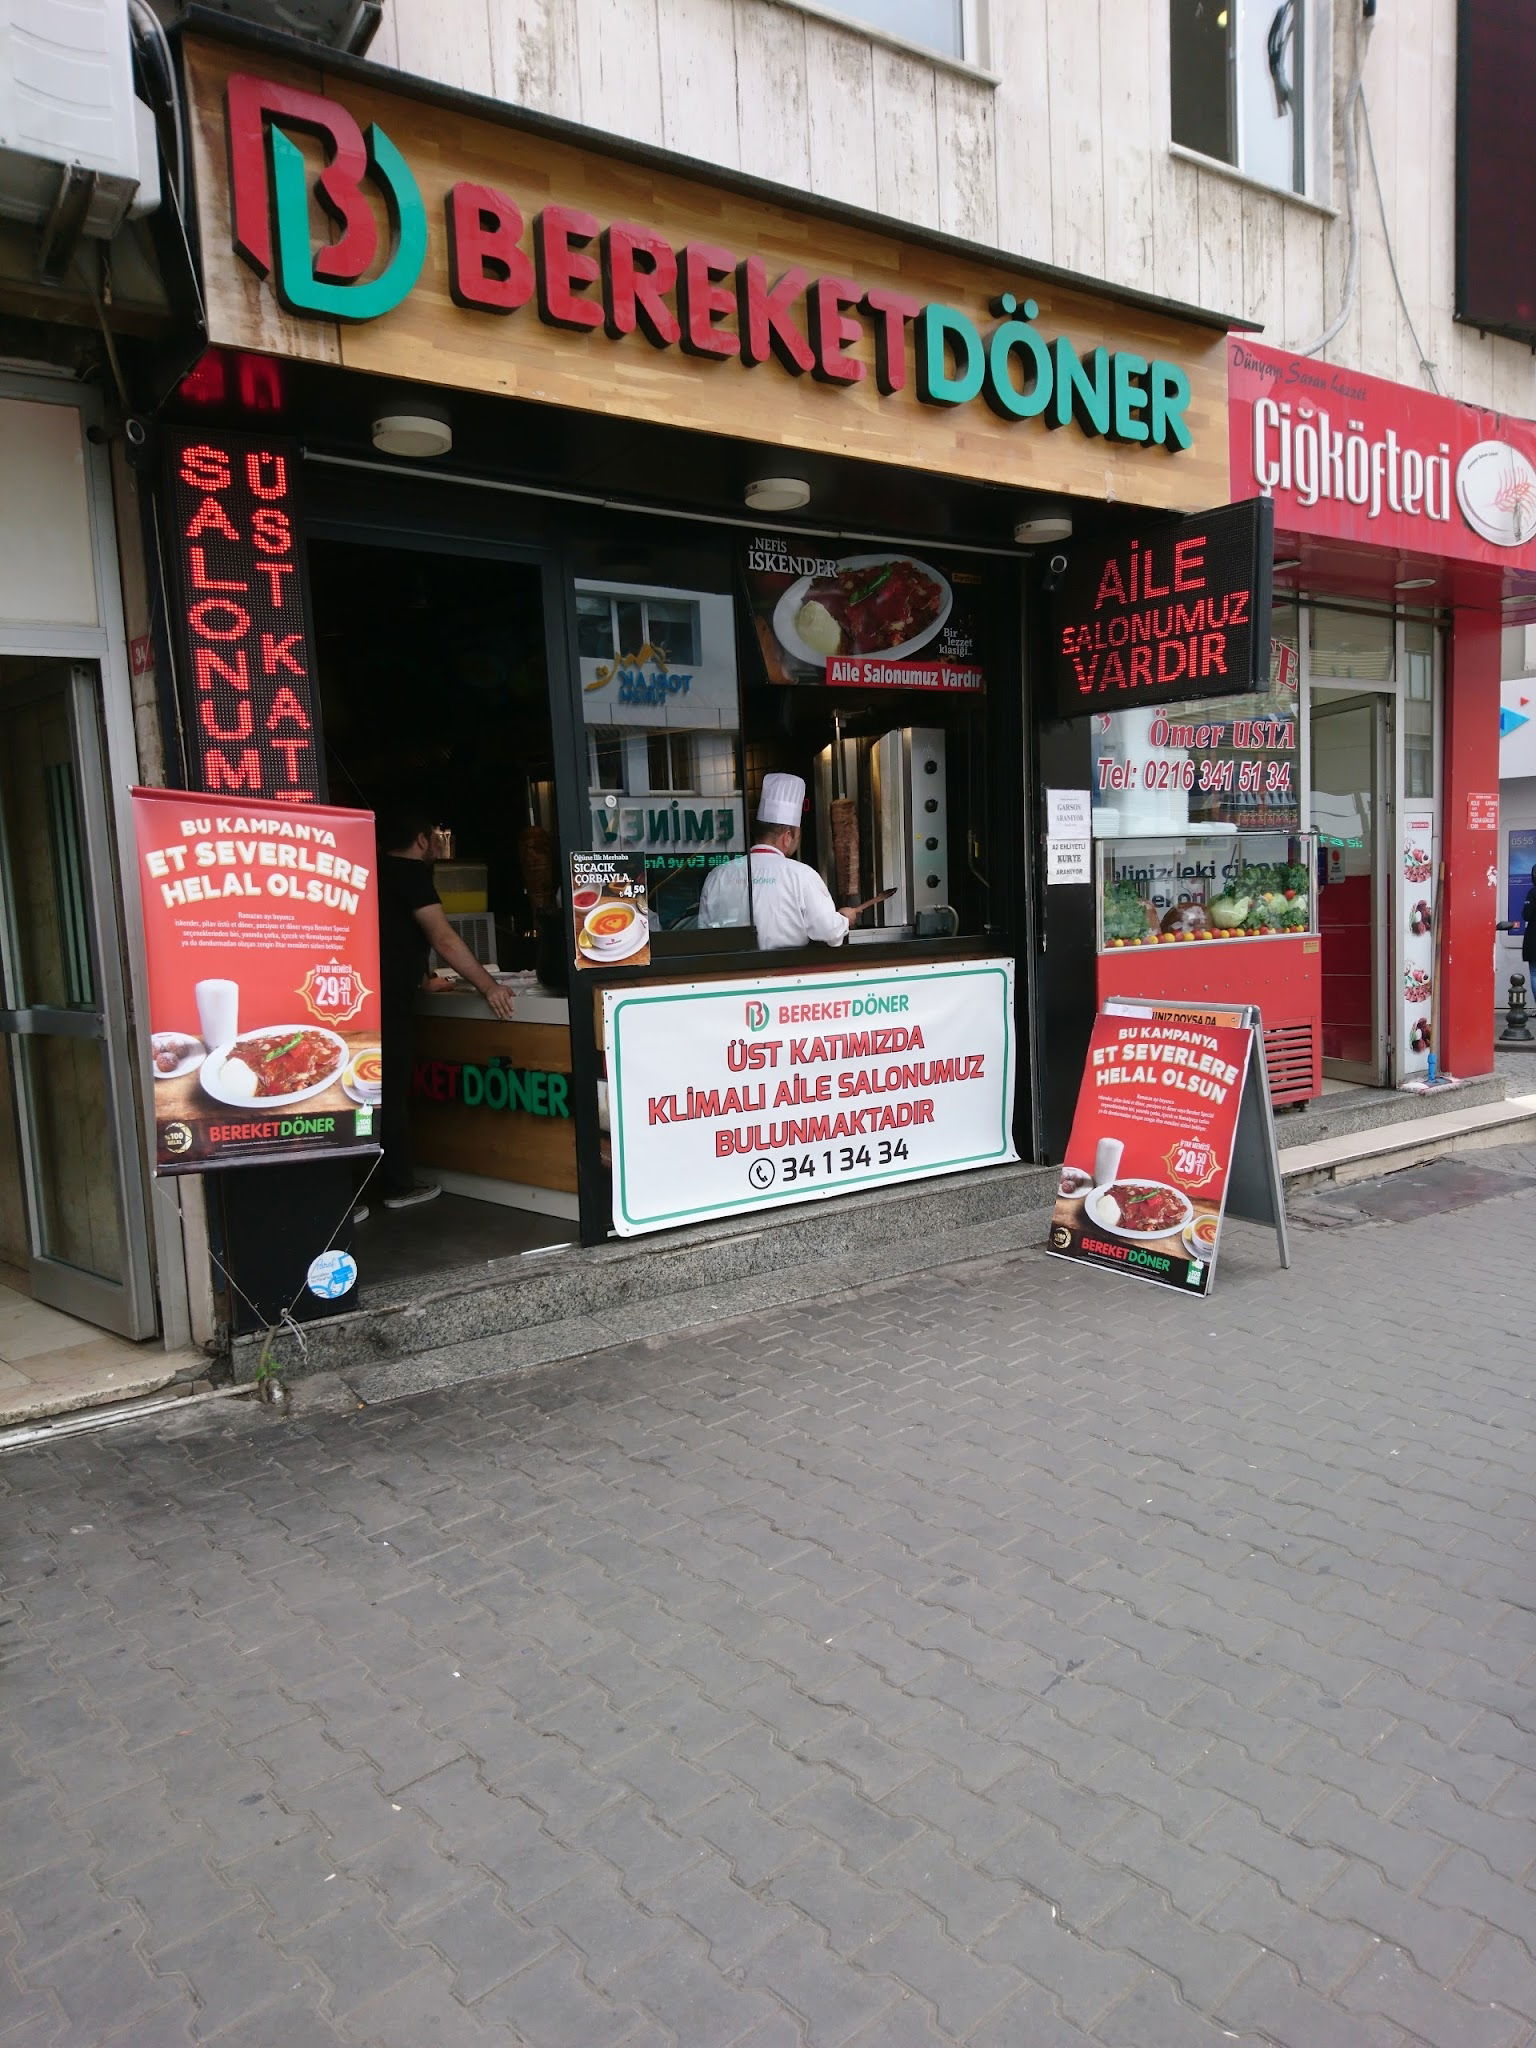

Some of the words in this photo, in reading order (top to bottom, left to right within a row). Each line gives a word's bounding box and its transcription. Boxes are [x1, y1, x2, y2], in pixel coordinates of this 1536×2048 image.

[446, 181, 1193, 452] BEREKETDÖNER
[1253, 397, 1450, 521] Çiğköfteci
[755, 537, 787, 553] NEFİS
[1094, 536, 1207, 611] AİLE
[943, 627, 959, 638] Bir
[947, 636, 973, 647] lezzet
[1062, 591, 1249, 655] SALONUMUZ
[832, 661, 860, 682] Aile
[864, 663, 938, 687] Salonumuz
[942, 668, 983, 689] Vardır
[1072, 632, 1228, 694] VARDIR
[1150, 708, 1224, 749] Ömer
[1233, 720, 1296, 749] USTA
[1098, 757, 1137, 790] Tel:
[1144, 759, 1195, 790] 0216
[1199, 760, 1234, 791] 341
[1239, 761, 1262, 791] 51
[1265, 761, 1290, 791] 34
[180, 818, 211, 837] BU
[216, 817, 336, 848] KAMPANYA
[145, 845, 188, 878] ET
[195, 841, 369, 890] SEVERLERE
[574, 863, 616, 873] SICACIK
[161, 872, 261, 908] HELAL
[267, 873, 359, 915] OLSUN
[778, 993, 909, 1025] BEREKETDÖNER
[727, 1038, 783, 1073] ÜST
[789, 1025, 925, 1066] KATIMIZDA
[1118, 1027, 1137, 1040] BU
[1140, 1027, 1218, 1051] KAMPANYA
[1093, 1045, 1119, 1066] ET
[1122, 1043, 1239, 1086] SEVERLERE
[648, 1085, 765, 1126] KLİMALI
[772, 1072, 831, 1108] AİLE
[838, 1054, 985, 1099] SALONUMUZ
[1096, 1066, 1157, 1087] HELAL
[1162, 1069, 1227, 1105] OLSUN
[209, 1116, 335, 1142] BEREKETDÖNER
[715, 1098, 935, 1158] BULUNMAKTADIR
[1081, 1237, 1171, 1272] BEREKETDÖNER
